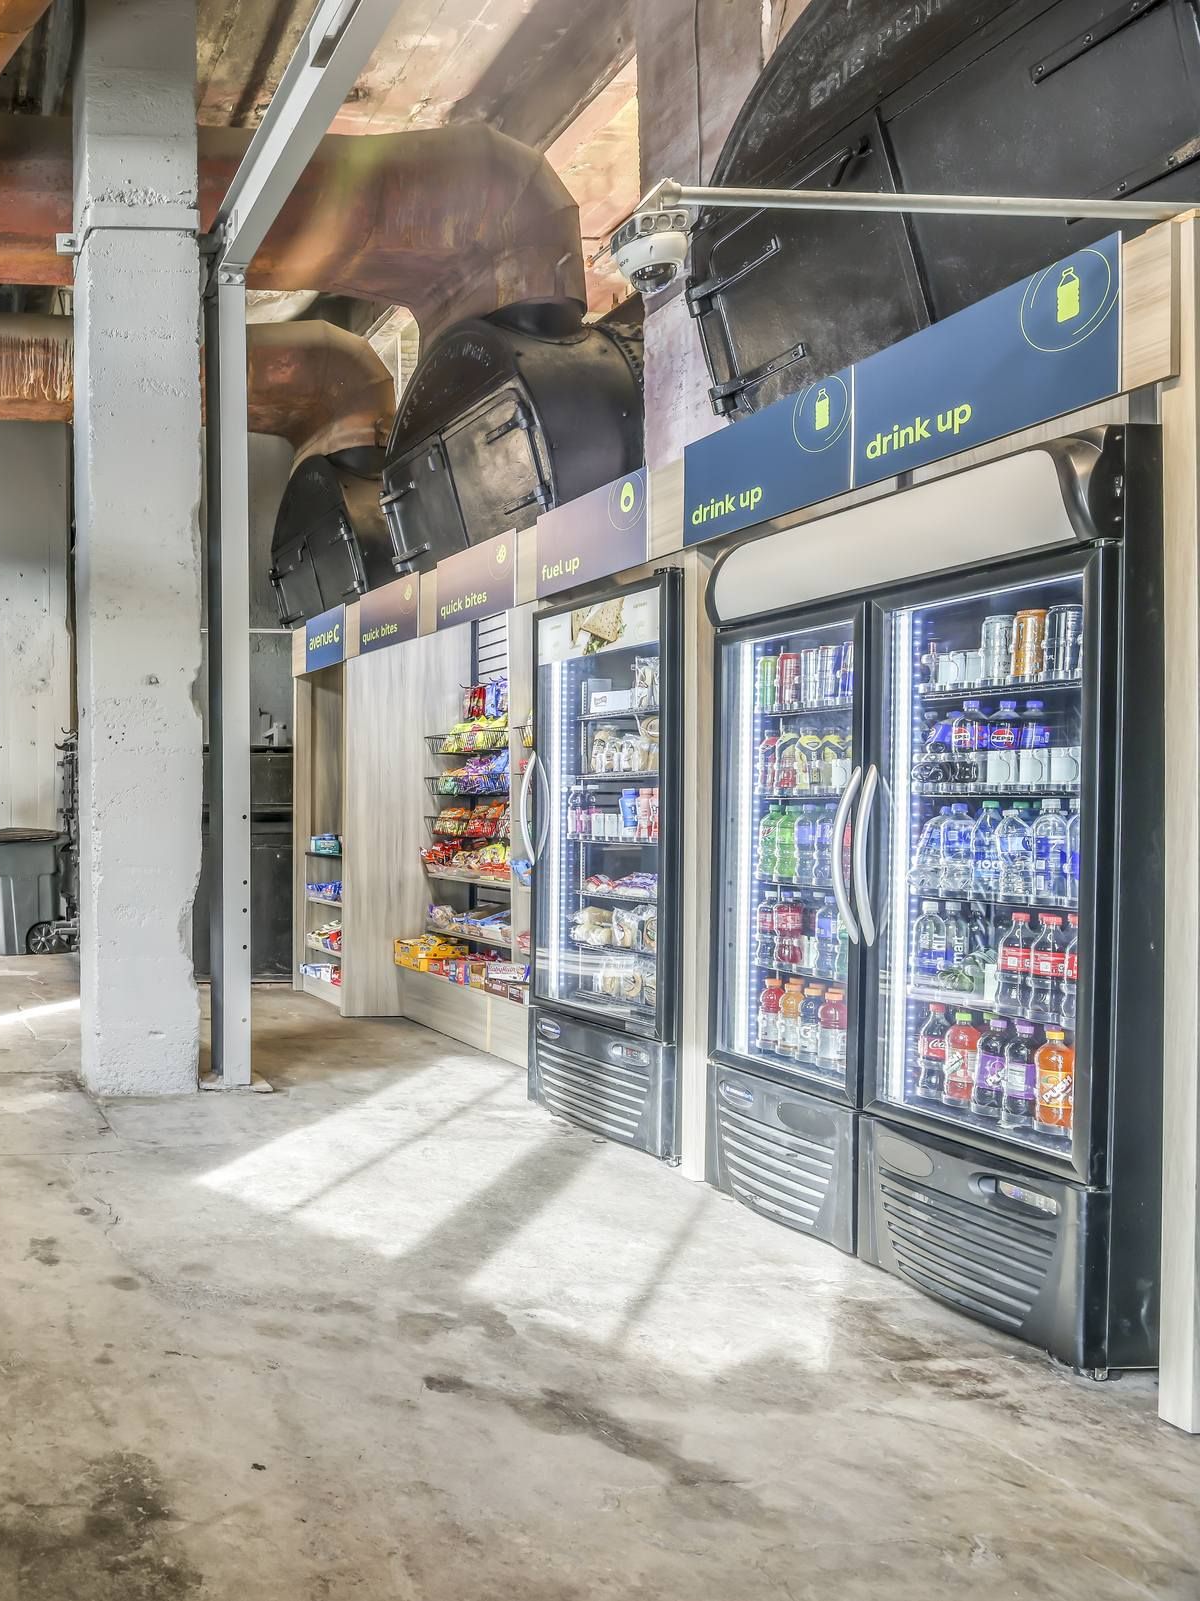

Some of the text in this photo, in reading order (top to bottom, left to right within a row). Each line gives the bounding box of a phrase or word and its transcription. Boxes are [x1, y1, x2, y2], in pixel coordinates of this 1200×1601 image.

[866, 403, 973, 460] drink up
[691, 486, 763, 526] drink up
[541, 556, 581, 582] fuel up
[440, 591, 488, 621] quick bites
[362, 623, 399, 646] quick bites
[991, 734, 1014, 742] PEPSI
[952, 935, 964, 966] mart
